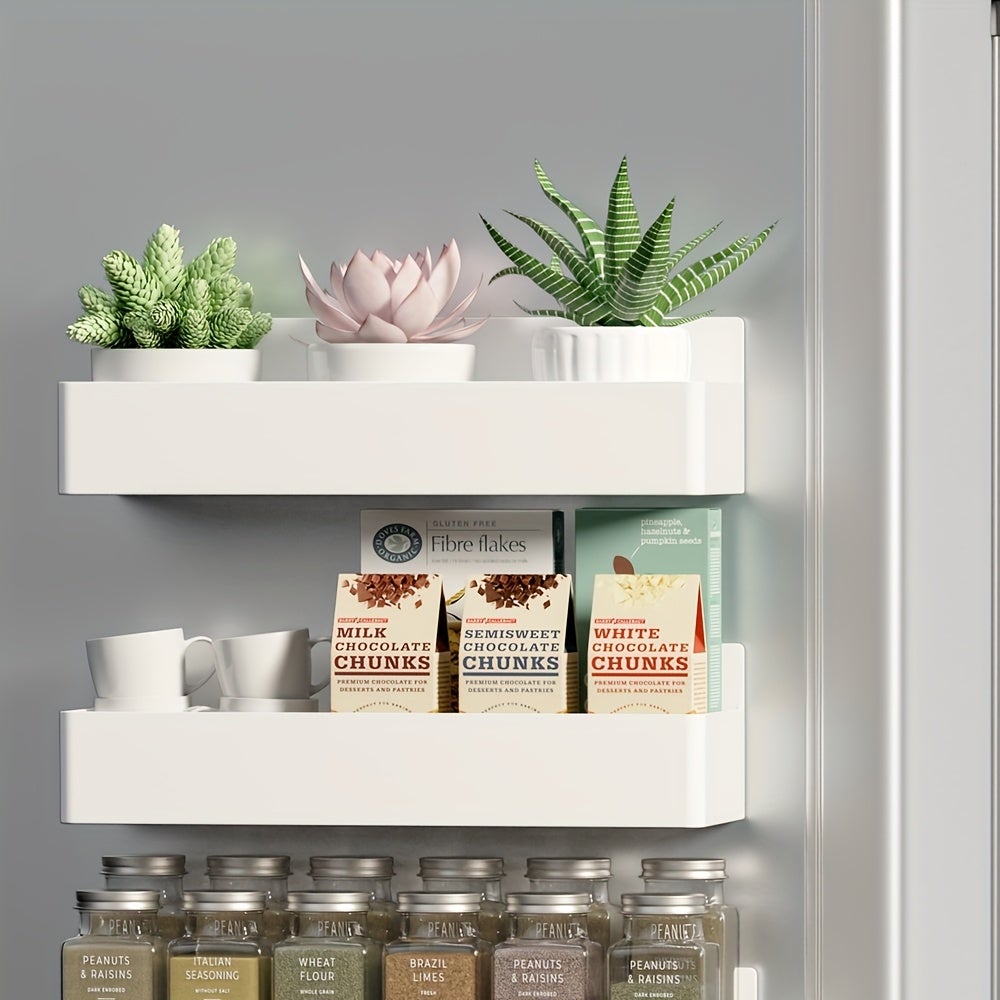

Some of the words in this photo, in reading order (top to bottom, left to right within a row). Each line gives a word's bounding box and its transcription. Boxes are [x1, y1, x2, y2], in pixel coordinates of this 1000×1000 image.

[432, 534, 473, 552] Fibre
[479, 534, 526, 552] flakes
[640, 537, 678, 545] pumpkin
[680, 537, 702, 545] seeds
[378, 548, 418, 562] ORGANIC
[336, 627, 387, 638] MILK
[464, 630, 560, 639] SEMISWEET
[594, 628, 660, 639] WHITE
[335, 642, 431, 651] CHOCOLATE
[464, 642, 560, 652] CHOCOLATE
[592, 643, 689, 652] CHOCOLATE
[334, 655, 430, 670] CHUNKS
[462, 656, 560, 670] CHUNKS
[591, 656, 688, 671] CHUNKS
[82, 955, 130, 966] PEANUTS
[193, 956, 232, 966] ITALIAN
[298, 957, 336, 968] WHEAT
[410, 958, 448, 969] BRAZIL
[513, 959, 562, 970] PEANUTS
[630, 960, 678, 970] PEANUTS
[80, 970, 87, 979] &
[91, 970, 132, 979] RAISINS
[185, 970, 240, 980] SEASONING
[300, 971, 335, 981] FLOUR
[413, 972, 445, 983] LIMES
[511, 974, 518, 984] &
[522, 974, 564, 984] RAISINS
[628, 974, 634, 984] &
[638, 974, 680, 984] RAISINS
